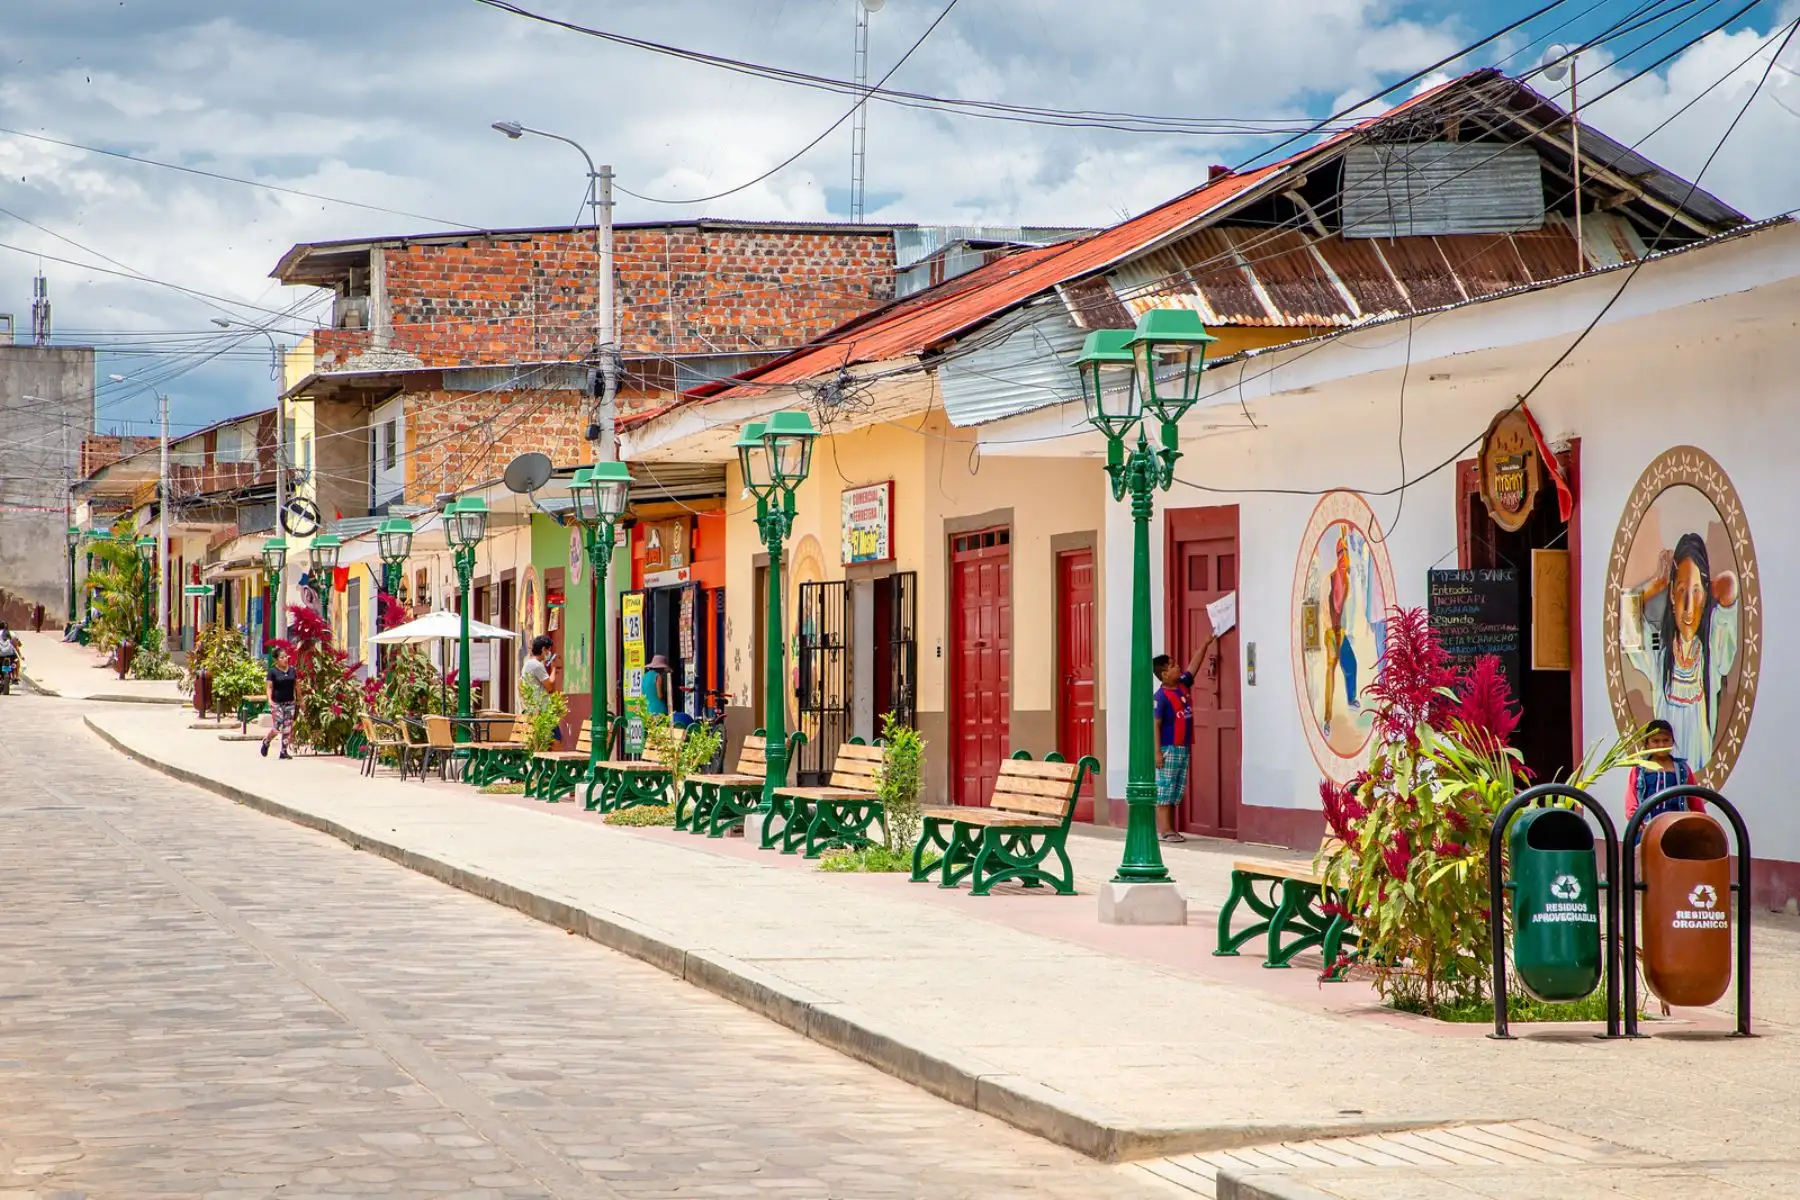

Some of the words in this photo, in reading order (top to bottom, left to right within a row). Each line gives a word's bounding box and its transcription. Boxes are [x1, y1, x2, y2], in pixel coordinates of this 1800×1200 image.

[1431, 584, 1473, 595] Entrada:
[1430, 614, 1475, 627] Segundo
[1546, 903, 1587, 912] RESIDUOS
[1532, 912, 1597, 923] APROVECHABLES
[1676, 910, 1726, 920] RESIDUOS
[1672, 920, 1728, 929] ORGANICOS
